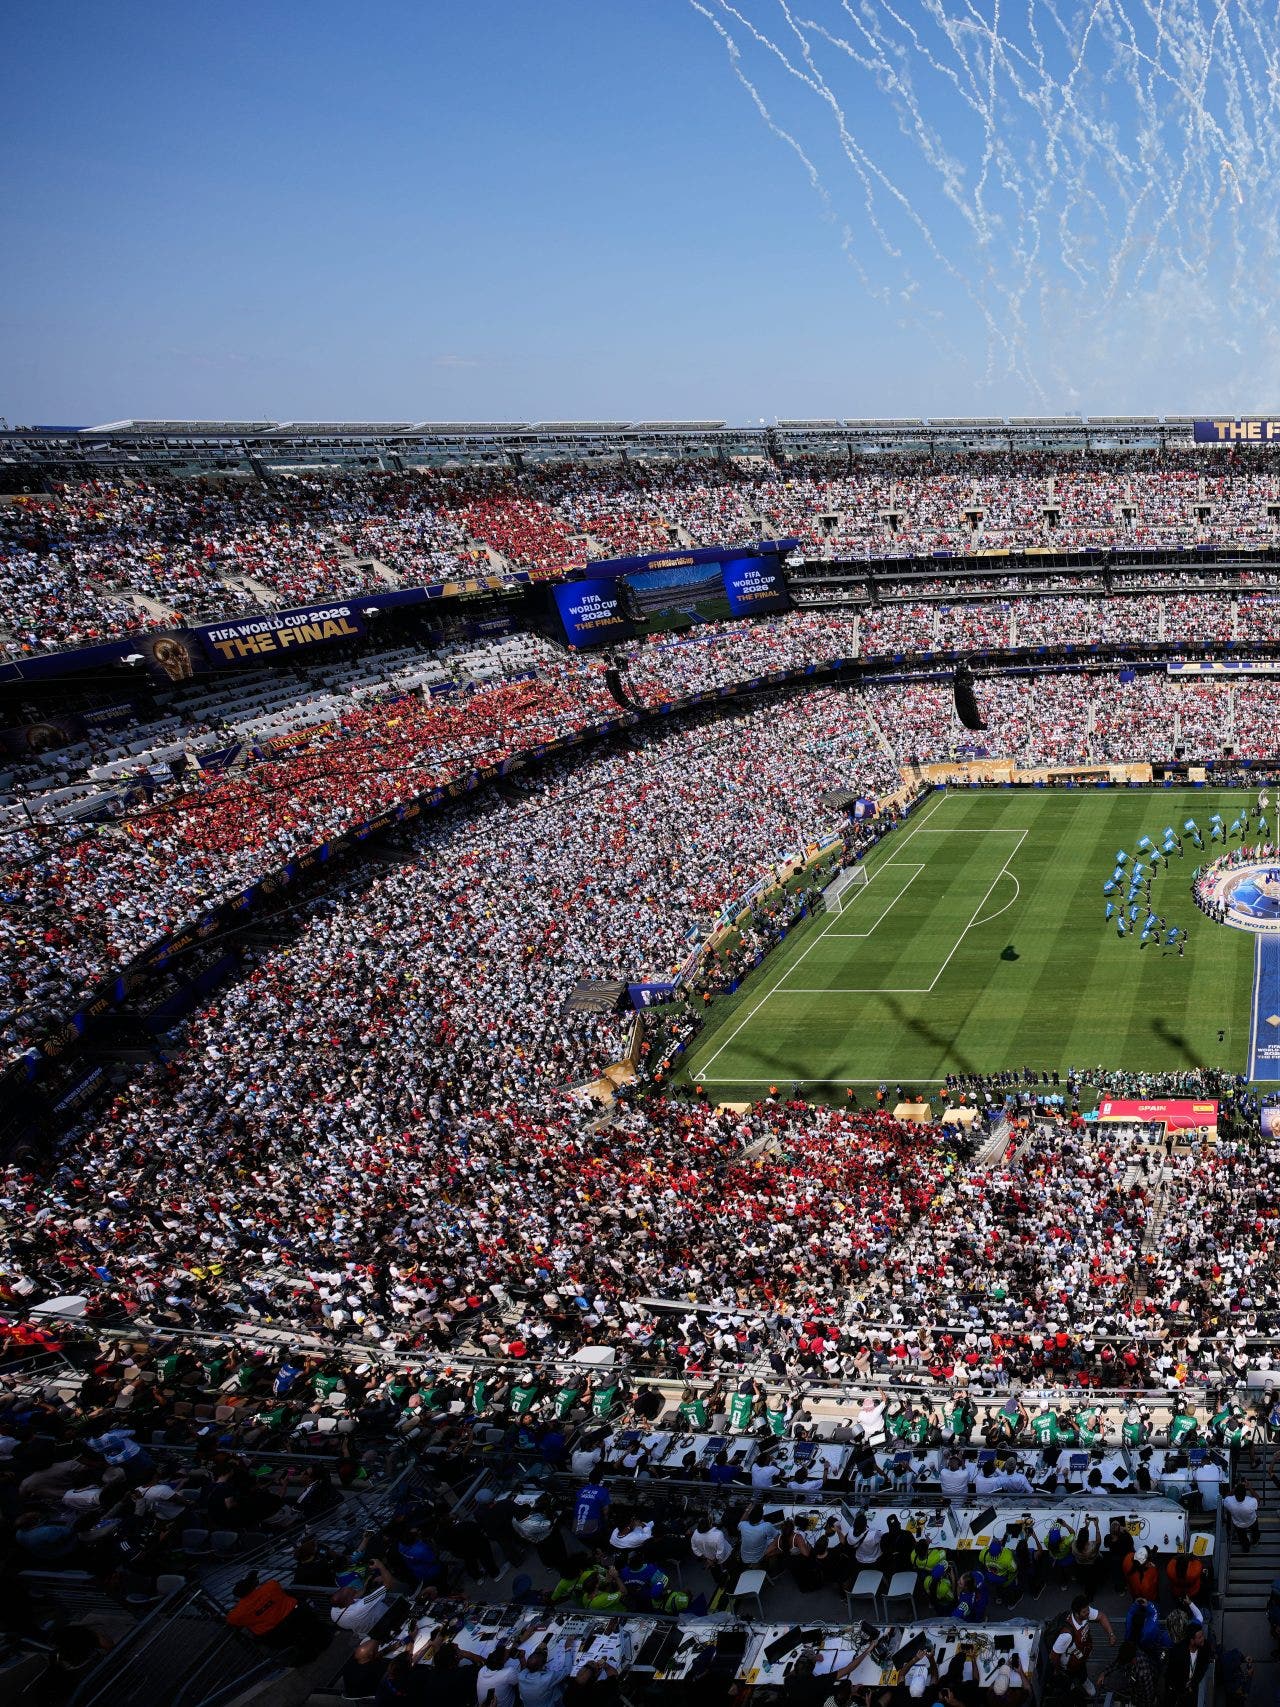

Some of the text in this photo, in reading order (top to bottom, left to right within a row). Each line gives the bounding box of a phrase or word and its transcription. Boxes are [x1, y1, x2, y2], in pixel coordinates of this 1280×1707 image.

[1213, 422, 1261, 439] THE
[733, 576, 775, 588] WORLD CUP
[743, 584, 769, 593] 2026
[582, 595, 601, 604] FIFA
[569, 600, 618, 615] WORLD CUP
[581, 610, 612, 621] 2026
[208, 607, 351, 642] FIFA WORLD CUP 2026
[574, 616, 624, 631] THE FINAL
[214, 617, 359, 660] THE FINAL
[370, 816, 391, 831] FINAL
[299, 856, 316, 870] FIFA
[231, 896, 249, 911] FIFA
[1244, 922, 1278, 930] WORLD
[168, 935, 193, 955] FINAL
[87, 999, 110, 1017] FIFA
